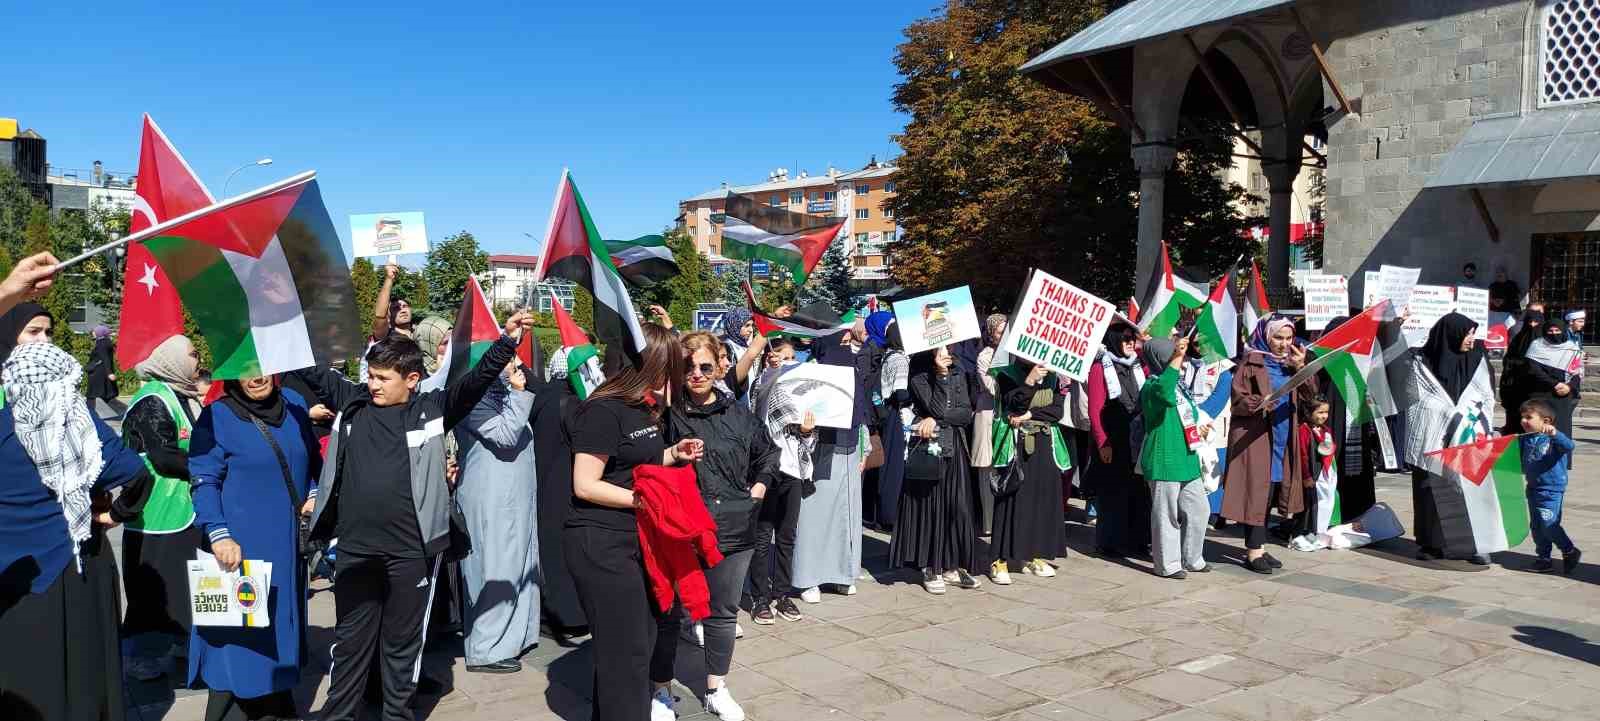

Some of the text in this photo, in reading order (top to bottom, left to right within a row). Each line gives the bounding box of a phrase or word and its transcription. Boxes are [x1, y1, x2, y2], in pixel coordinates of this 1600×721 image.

[1031, 298, 1094, 338] STUDENTS
[1039, 278, 1106, 322] THANKS TO
[1016, 334, 1085, 376] WITH GAZA
[1025, 318, 1089, 357] STANDING
[195, 604, 228, 613] FENER
